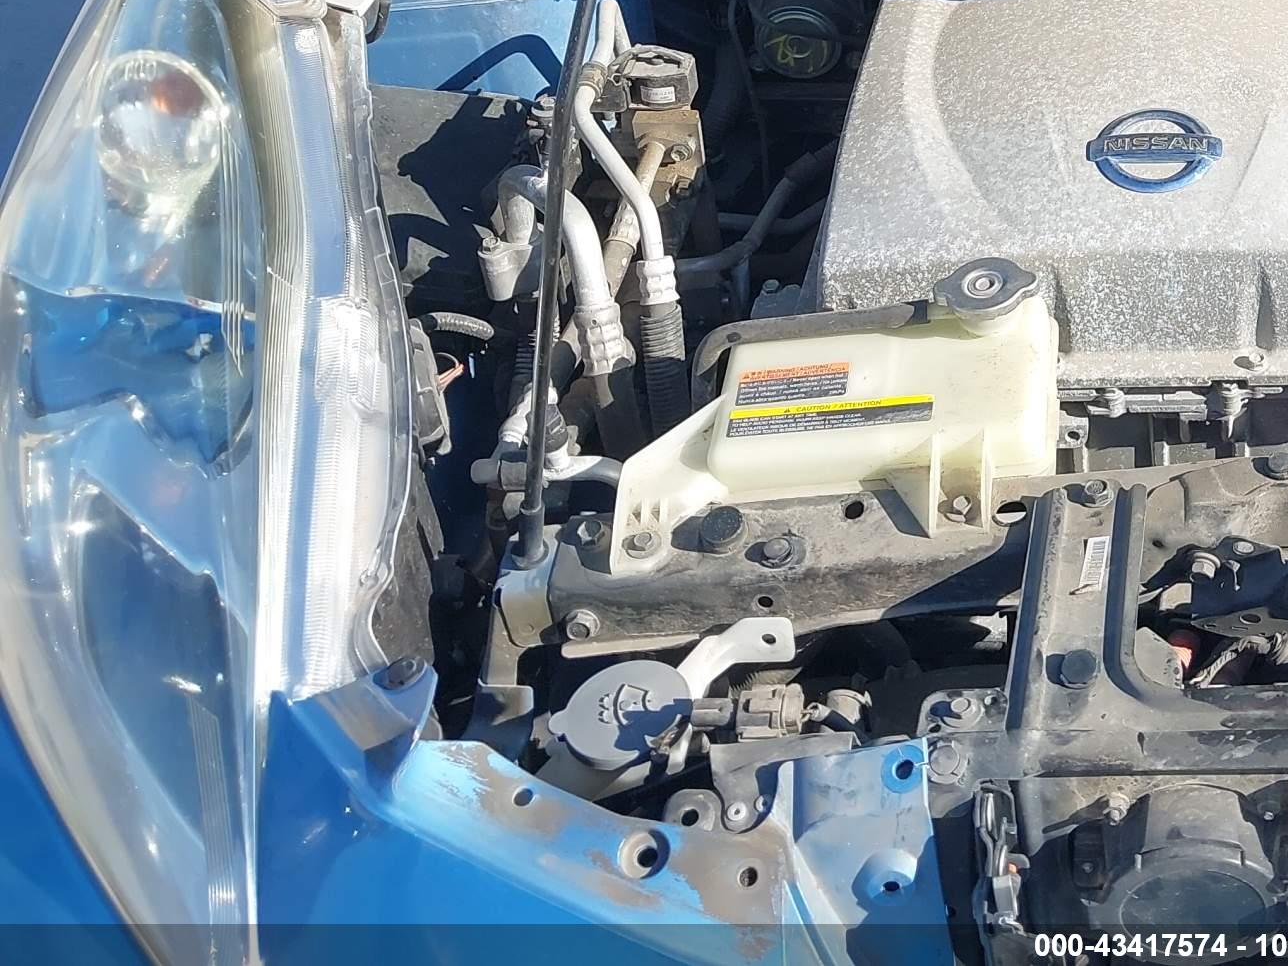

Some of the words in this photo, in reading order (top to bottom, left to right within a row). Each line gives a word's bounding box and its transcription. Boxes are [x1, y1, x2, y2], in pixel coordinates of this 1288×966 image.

[1103, 136, 1208, 153] NISSAN
[796, 404, 831, 413] CAUTION
[840, 400, 882, 409] ATTENTION
